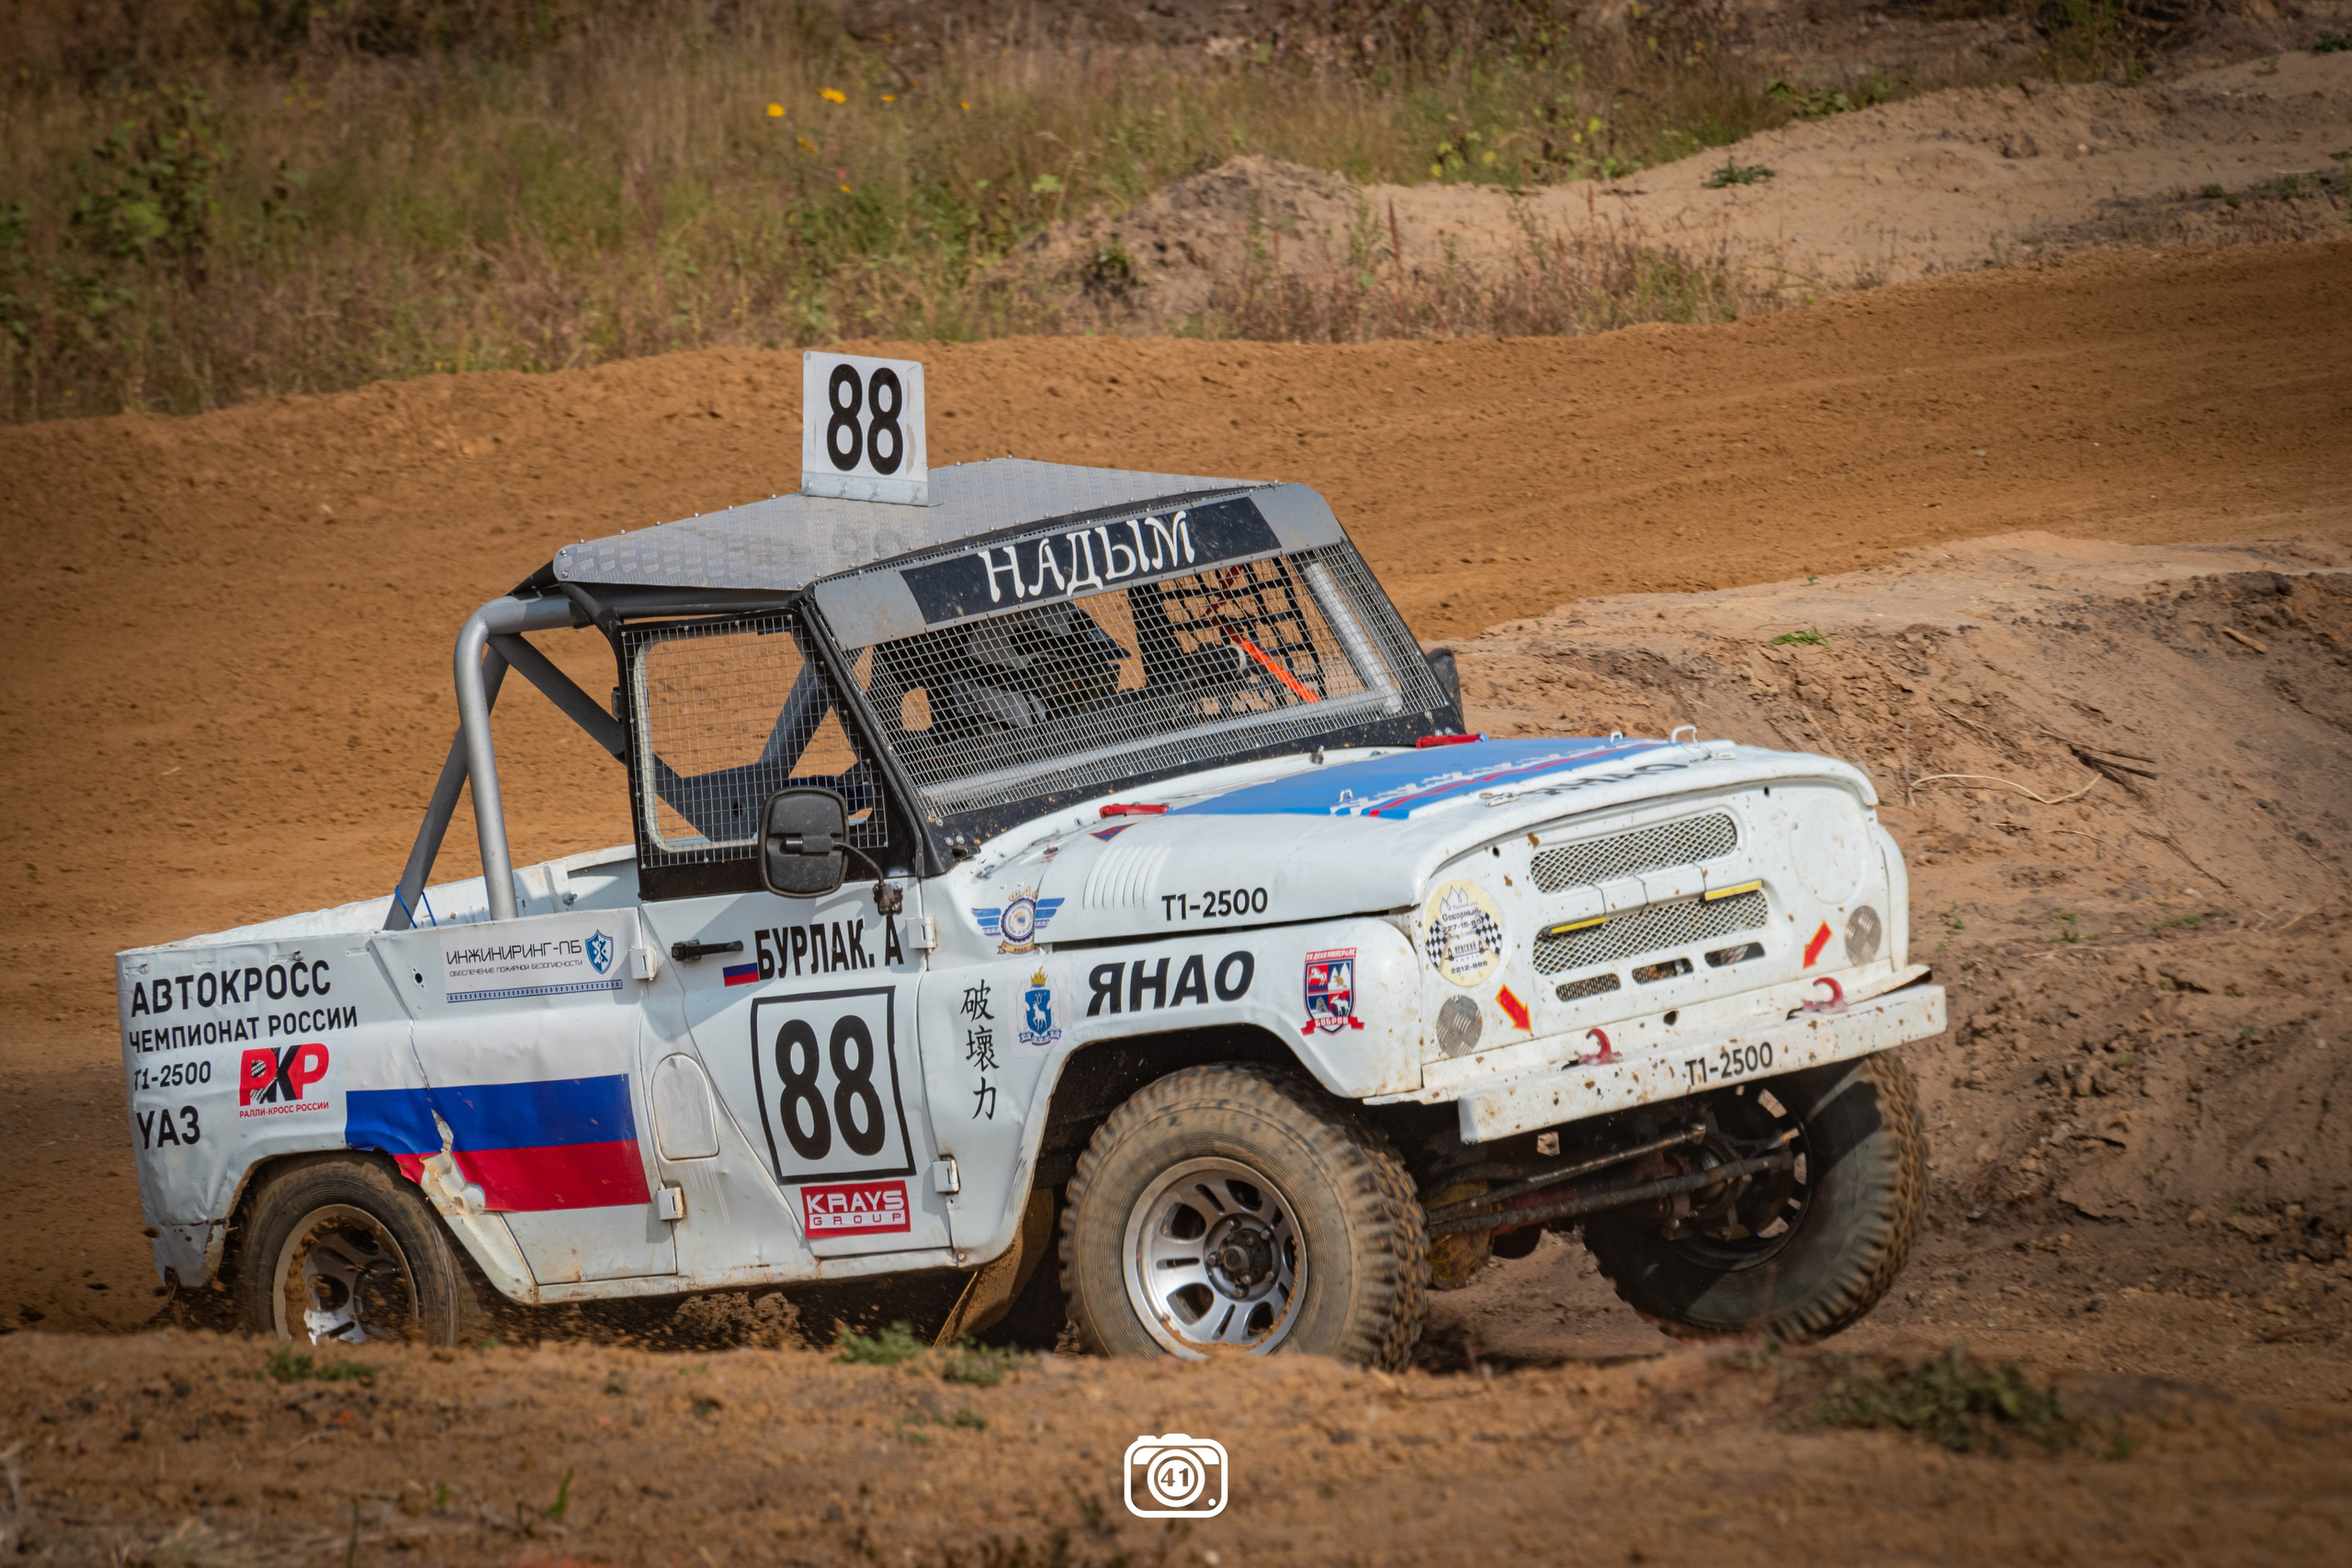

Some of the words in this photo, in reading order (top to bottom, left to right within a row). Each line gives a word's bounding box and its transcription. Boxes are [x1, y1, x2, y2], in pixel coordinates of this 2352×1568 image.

[827, 363, 903, 476] 88
[977, 510, 1195, 604] НАДЫМ
[1161, 886, 1269, 921] Т1-2500
[446, 939, 582, 965] ИНЖИНИРИНГ-ПБ
[449, 967, 495, 977] ОБЕСПЕЧЕНИЕ
[496, 964, 530, 974] ПОЖАРНОЙ
[531, 959, 583, 970] БЕЗОПАСНОСТИ
[754, 919, 876, 981] БУРЛАК.
[884, 917, 905, 966] А
[130, 959, 331, 1017] АВТОКРОСС
[1086, 950, 1255, 1018] ЯНАО
[129, 1016, 260, 1054] ЧЕМПИОНАТ
[268, 1005, 358, 1038] РОССИИ
[1315, 1016, 1349, 1028] БОБРОВ
[960, 978, 1001, 1122] 破壞力
[1685, 1042, 1773, 1086] Т1-2500
[239, 1104, 294, 1119] РАЛЛИ-КРОСС
[296, 1101, 330, 1112] РОССИИ
[775, 1015, 887, 1161] 88
[136, 1105, 201, 1150] УАЗ
[806, 1190, 905, 1214] KRAYS
[813, 1213, 902, 1226] GROUP
